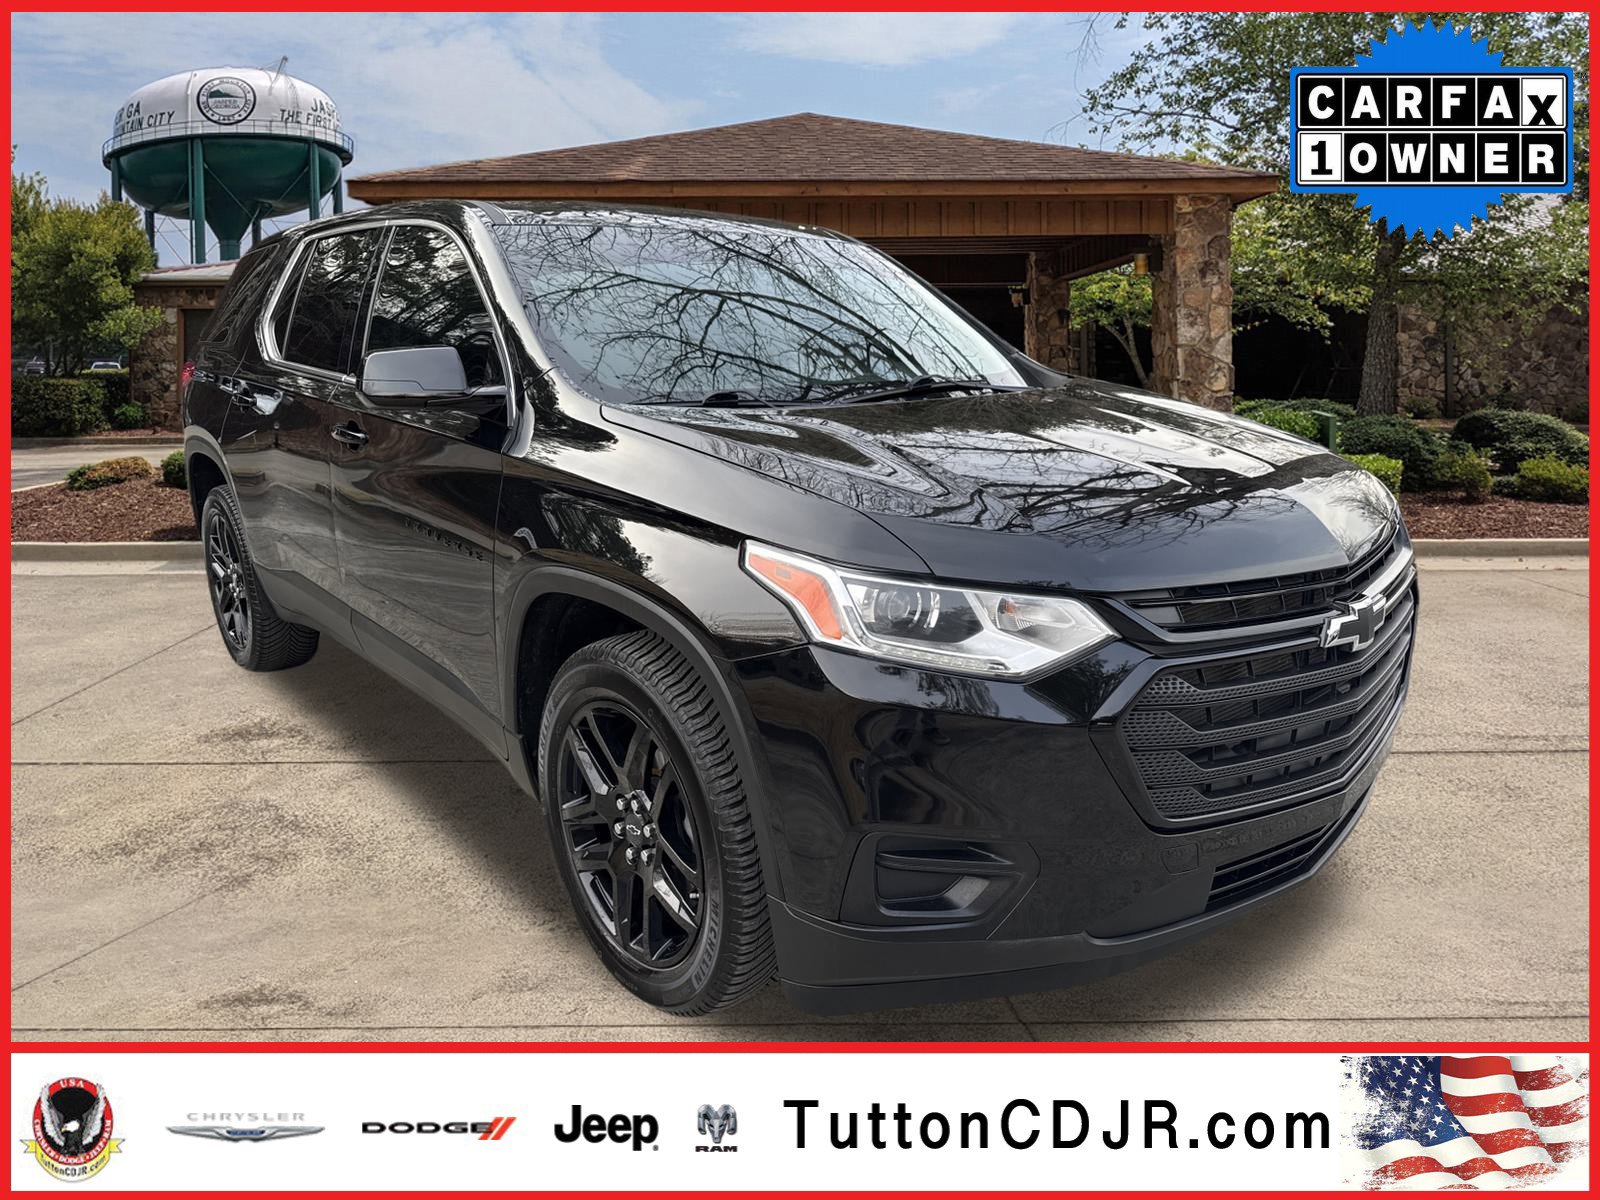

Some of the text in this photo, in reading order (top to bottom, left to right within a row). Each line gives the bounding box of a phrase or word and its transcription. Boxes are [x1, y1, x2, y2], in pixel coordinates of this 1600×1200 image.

[126, 100, 141, 119] GA
[280, 108, 302, 124] THE
[147, 110, 176, 128] CITY
[692, 898, 721, 987] MICHELIN
